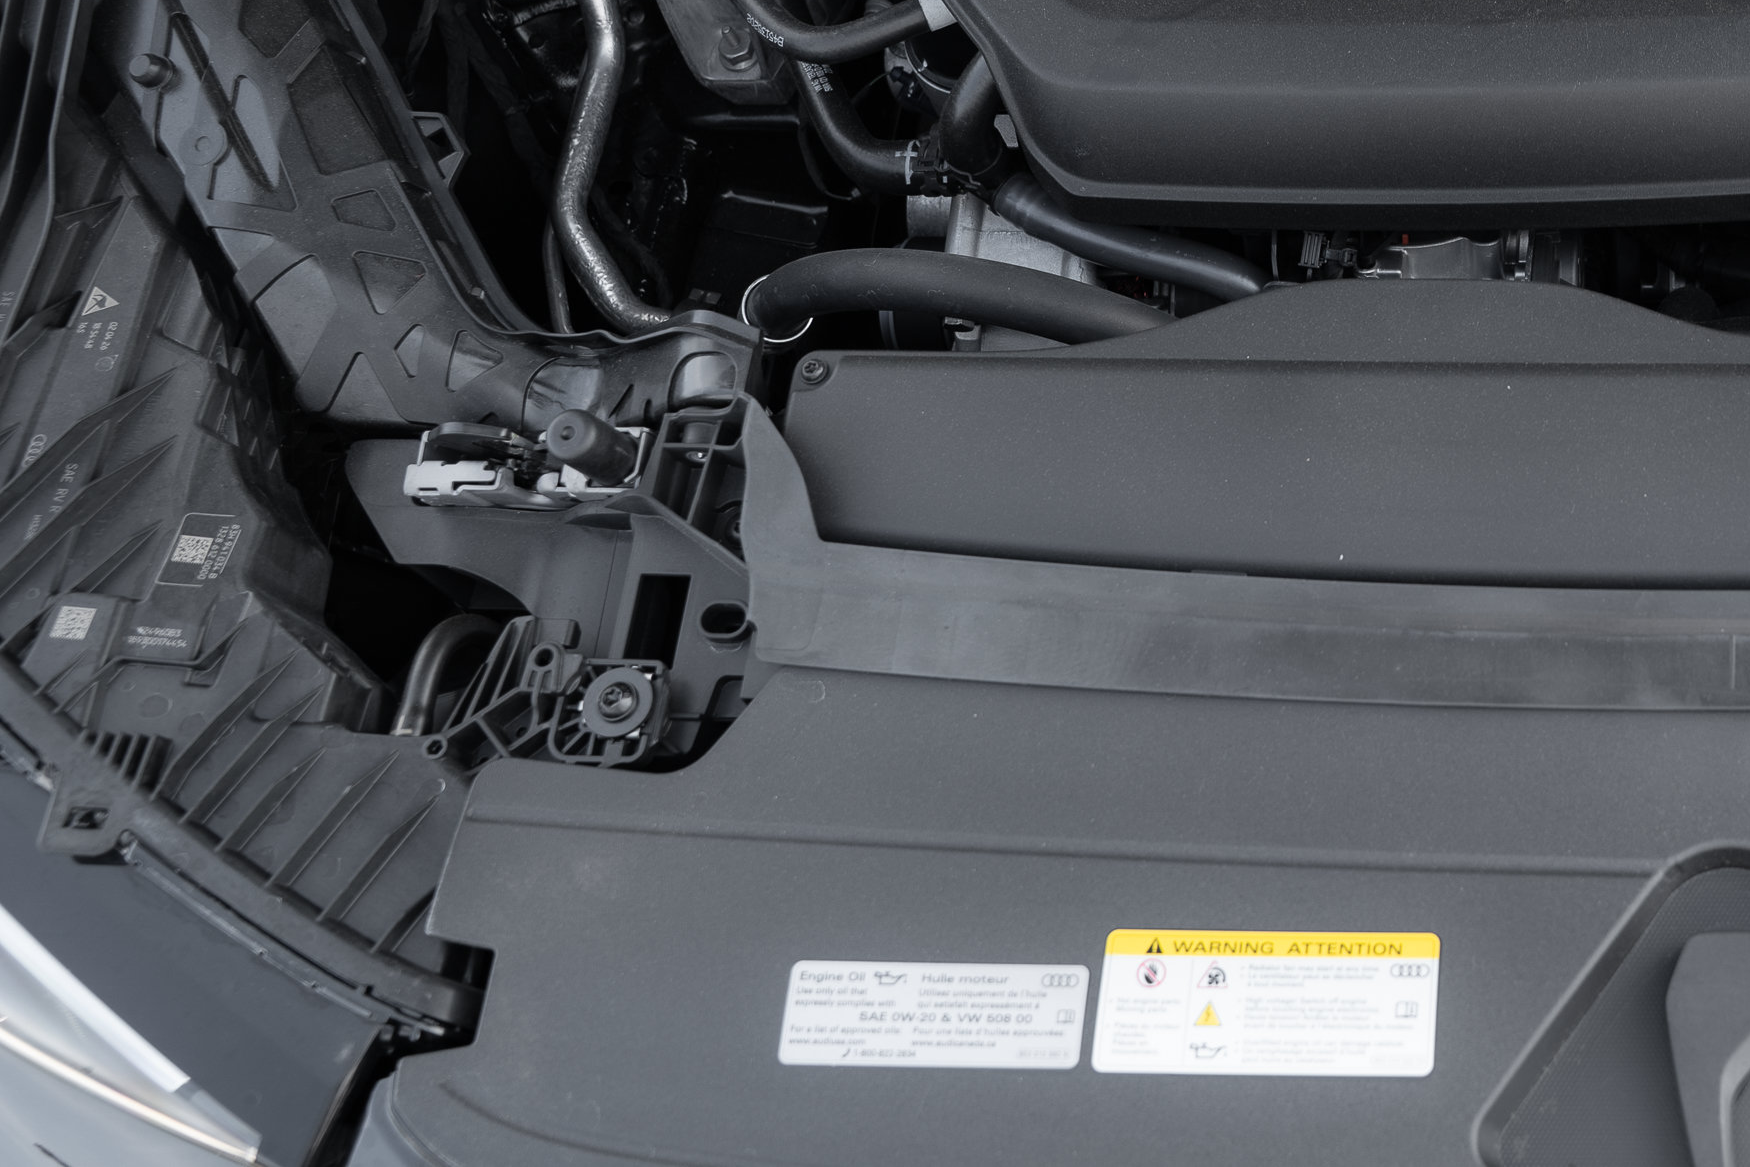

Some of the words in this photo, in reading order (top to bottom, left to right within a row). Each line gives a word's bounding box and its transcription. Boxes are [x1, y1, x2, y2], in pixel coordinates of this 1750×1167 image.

[59, 464, 79, 482] SAE
[1173, 941, 1274, 954] WARNING
[1287, 941, 1404, 955] ATTENTION
[800, 970, 844, 983] Engine
[848, 971, 866, 982] Oil
[922, 973, 955, 984] Huile
[959, 974, 1008, 984] moteur
[859, 1011, 888, 1021] SAE
[892, 1011, 936, 1022] 0W-20
[941, 1013, 952, 1022] &
[958, 1013, 982, 1022] VW
[987, 1014, 1012, 1023] 508
[1016, 1014, 1033, 1024] 00
